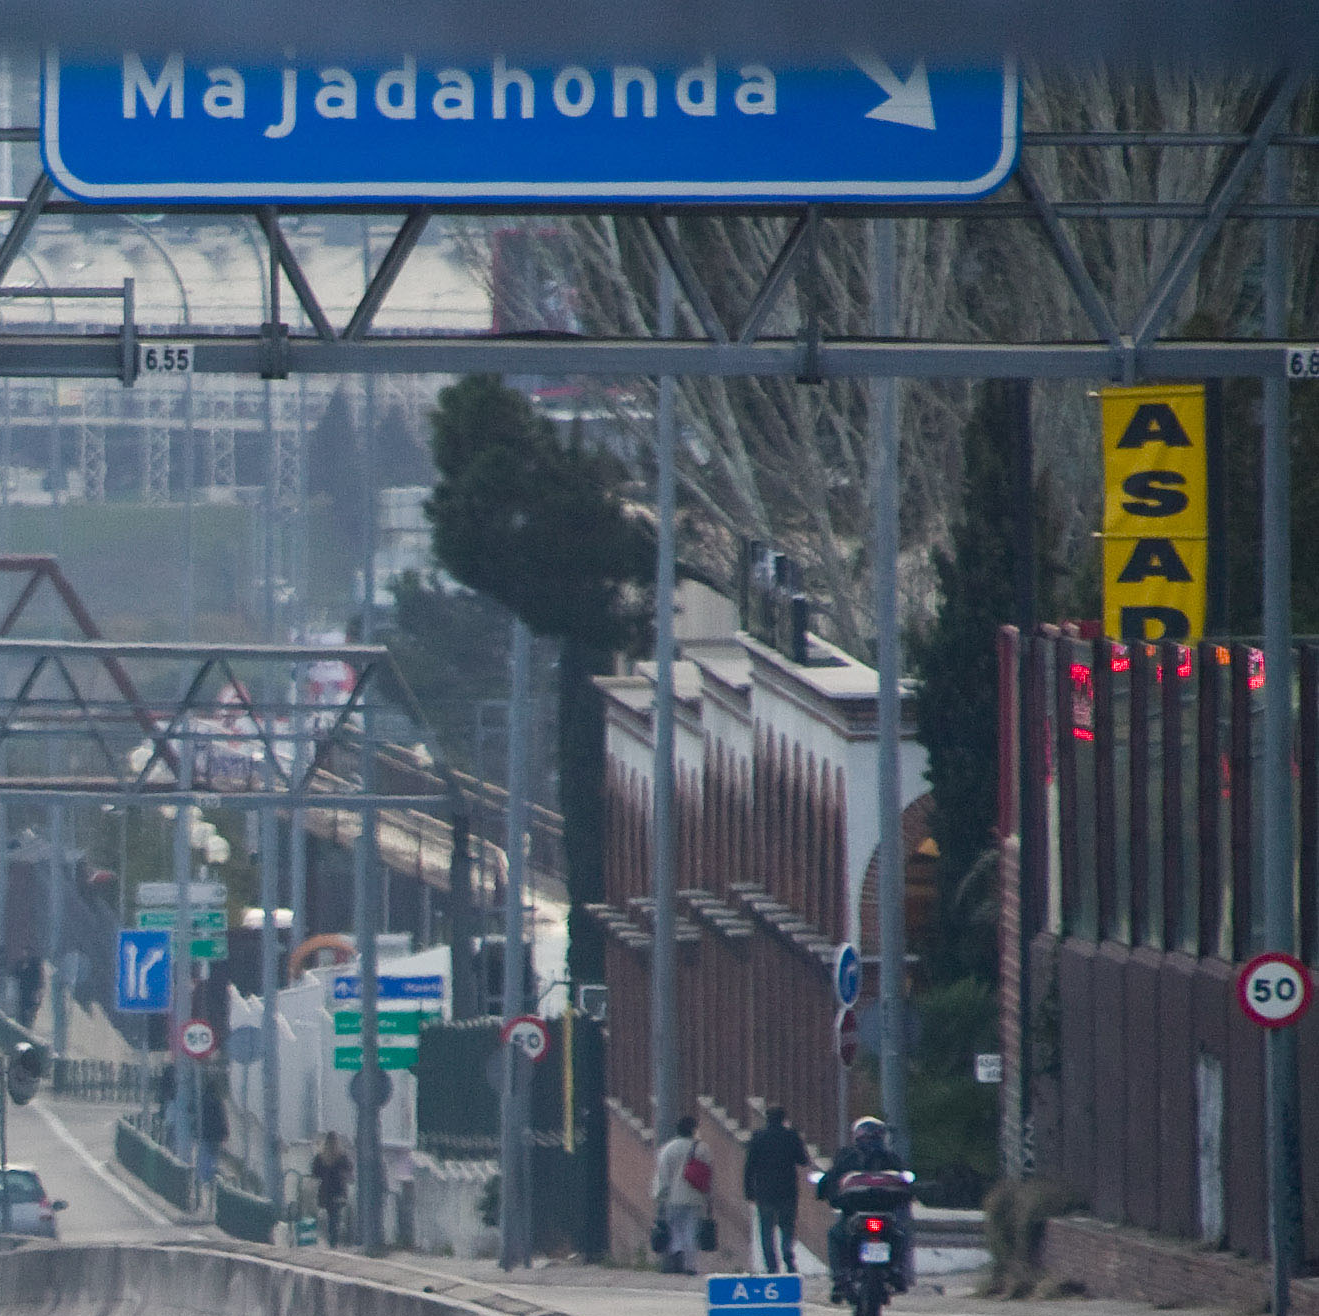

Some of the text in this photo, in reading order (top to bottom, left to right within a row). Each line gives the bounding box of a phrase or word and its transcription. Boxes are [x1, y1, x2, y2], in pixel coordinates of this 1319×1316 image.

[121, 54, 778, 138] Majadahonda
[146, 349, 189, 373] 6,55
[1253, 977, 1296, 1002] 50
[732, 1281, 779, 1301] A-6
